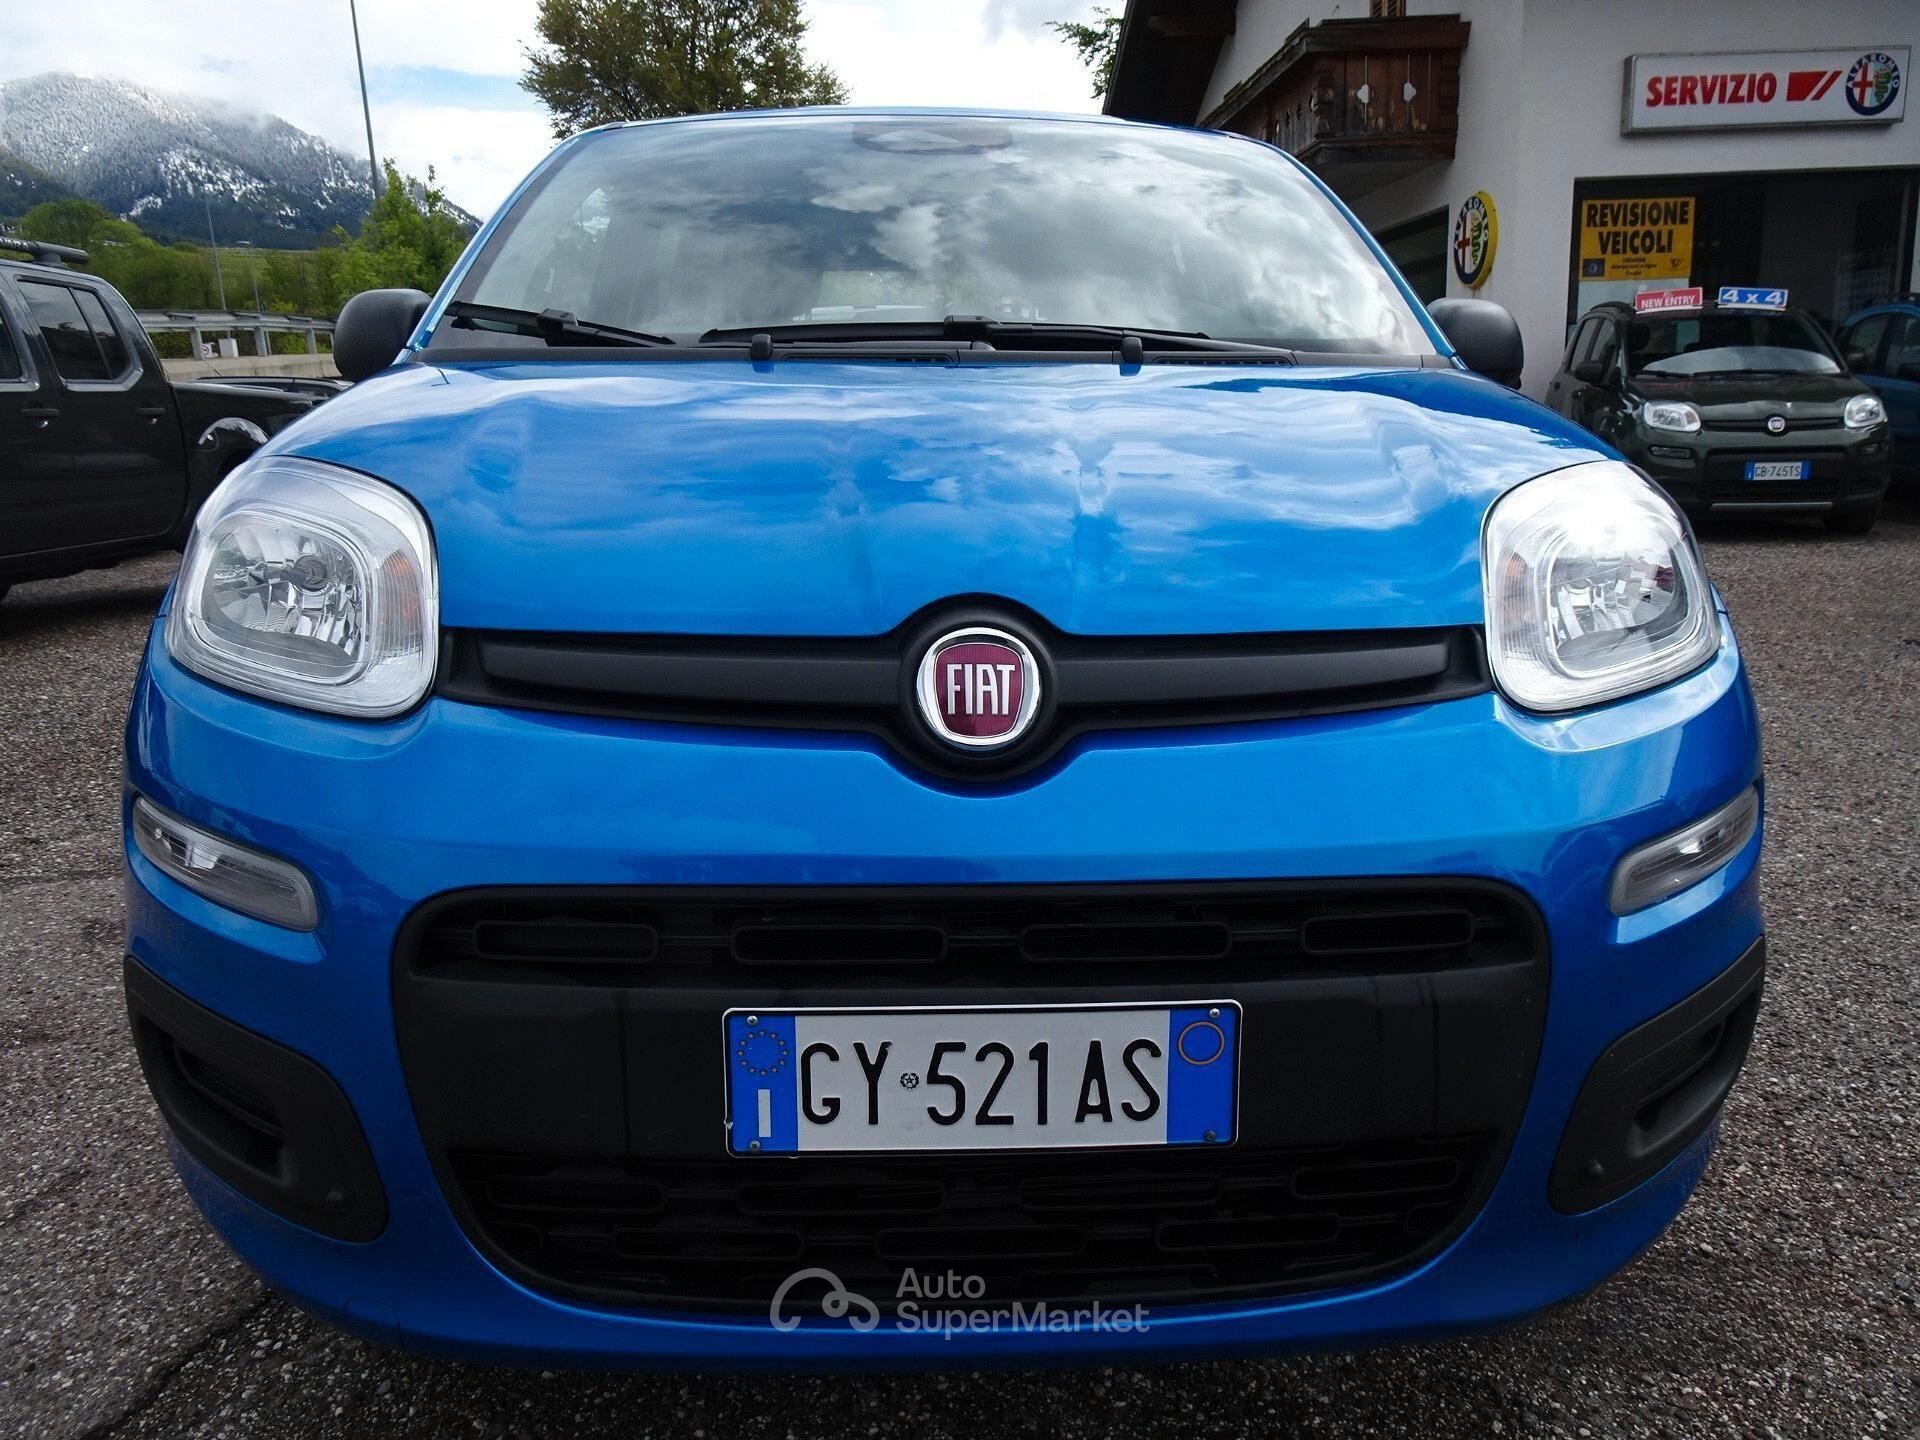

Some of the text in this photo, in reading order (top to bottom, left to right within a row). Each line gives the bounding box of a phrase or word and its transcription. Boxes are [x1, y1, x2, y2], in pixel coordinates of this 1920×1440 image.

[1645, 72, 1777, 107] SERVIZIO
[1586, 201, 1690, 228] REVISIONE
[1598, 229, 1674, 255] VEICOLI
[1641, 295, 1695, 309] NEW ENTRY
[1722, 289, 1739, 302] 4
[1764, 290, 1783, 304] 4
[946, 664, 1015, 715] FIAT
